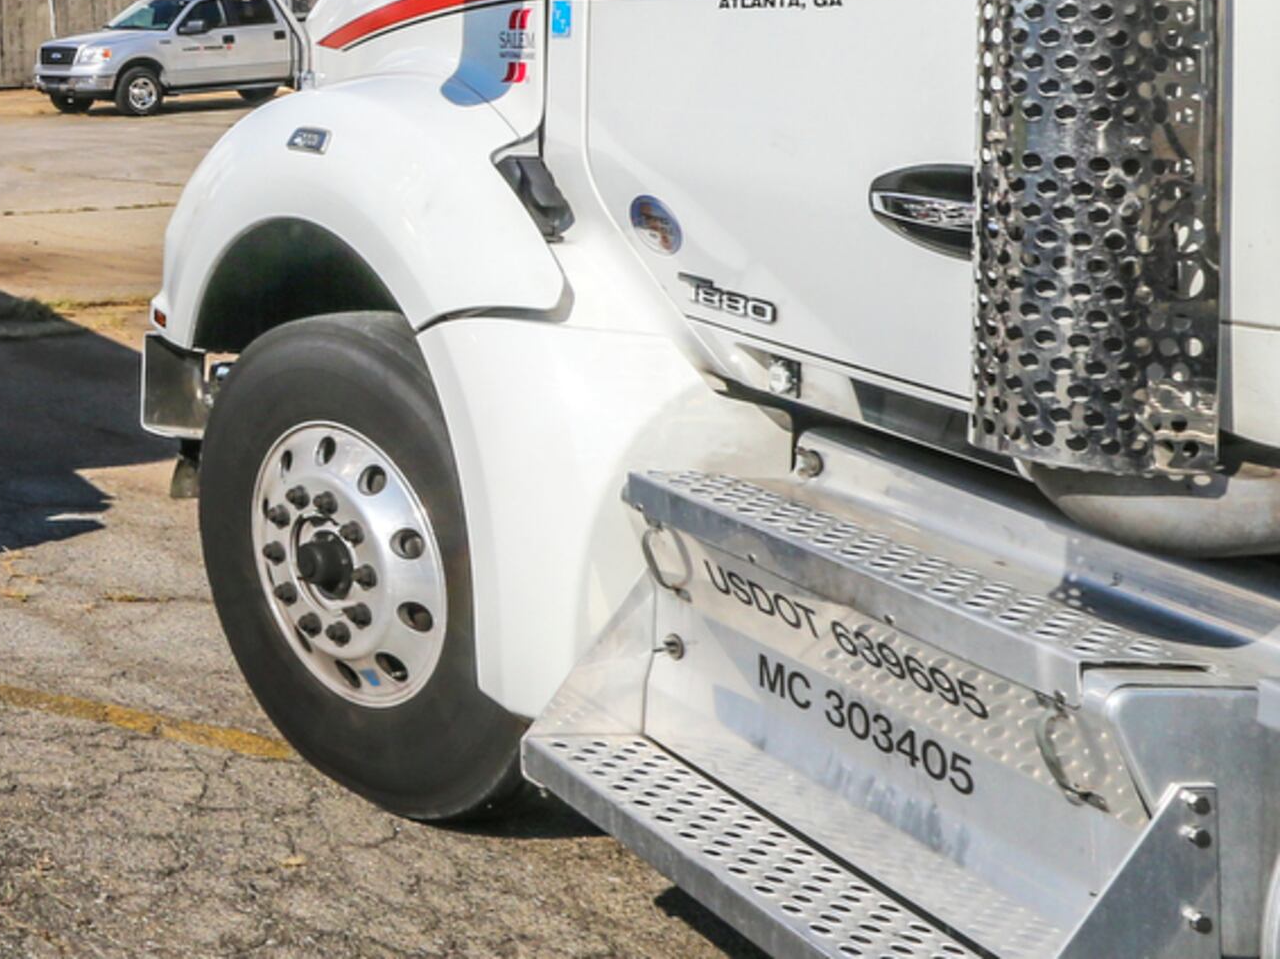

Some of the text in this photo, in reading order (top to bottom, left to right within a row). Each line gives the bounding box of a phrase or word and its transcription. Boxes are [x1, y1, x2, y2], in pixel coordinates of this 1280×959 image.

[678, 271, 778, 325] T880
[704, 559, 990, 720] USDOT 639695
[758, 653, 975, 795] MC 303405
